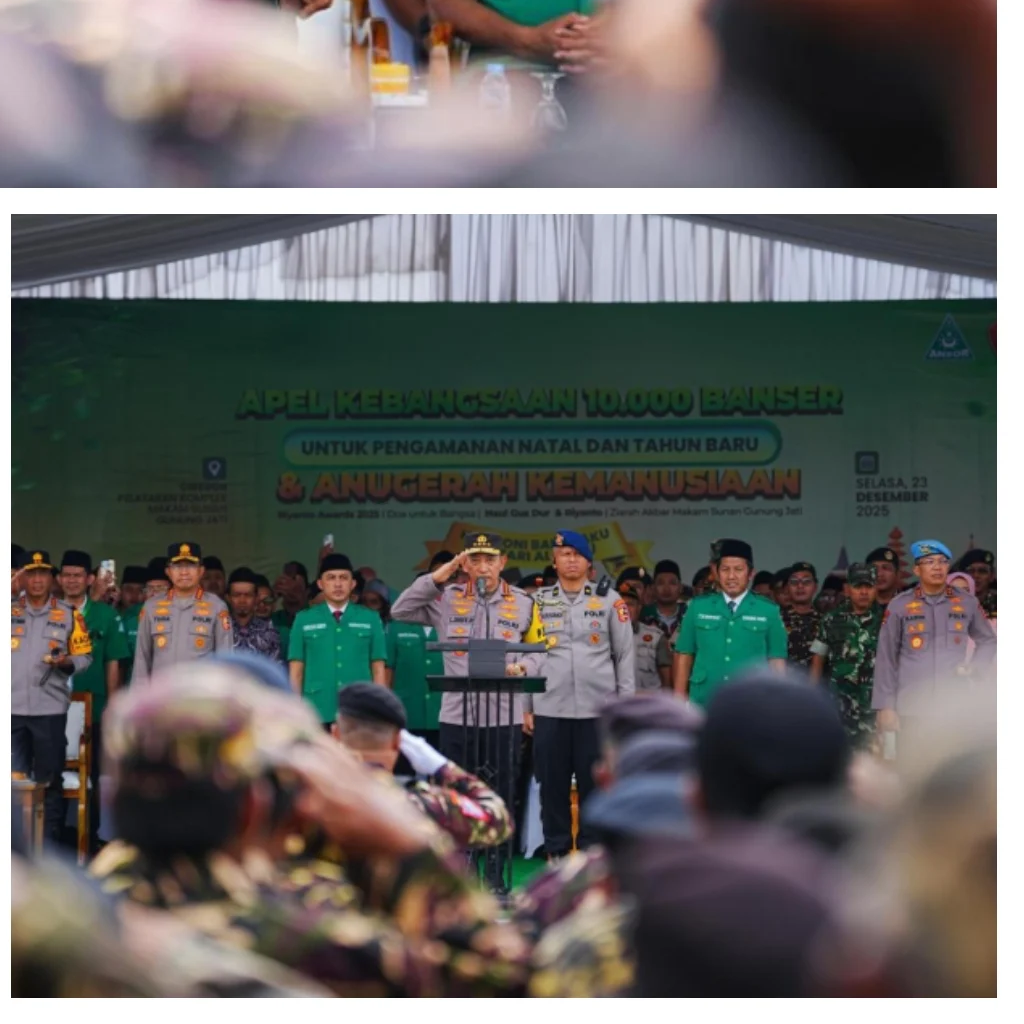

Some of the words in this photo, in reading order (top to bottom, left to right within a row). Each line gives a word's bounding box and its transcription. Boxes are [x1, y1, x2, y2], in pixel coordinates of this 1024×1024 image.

[235, 387, 330, 420] APEL
[333, 387, 575, 419] KEBANGSAAN
[581, 386, 693, 417] 10.000
[698, 384, 845, 417] BANSER
[300, 439, 368, 457] UNTUK
[372, 439, 514, 456] PENGAMANAN
[518, 438, 584, 456] NATAL
[586, 438, 630, 455] DAN
[632, 438, 700, 454] TAHUN
[704, 437, 760, 454] BARU
[277, 473, 306, 503] &
[310, 471, 519, 504] ANUGERAH
[525, 468, 803, 502] KEMANUSIAAN
[911, 476, 929, 489] 23
[856, 491, 929, 503] DESEMBER
[856, 504, 890, 518] 2025
